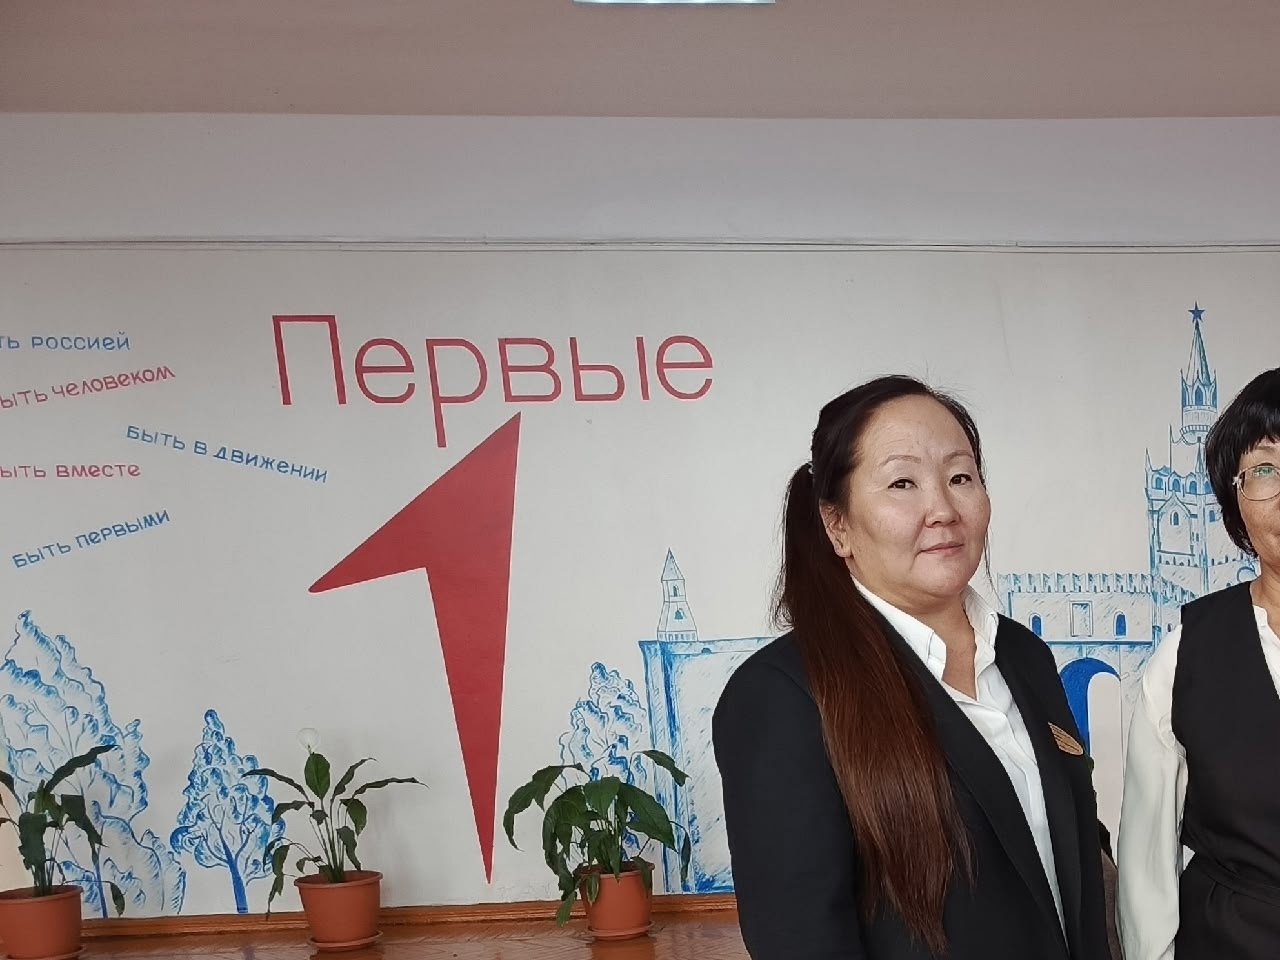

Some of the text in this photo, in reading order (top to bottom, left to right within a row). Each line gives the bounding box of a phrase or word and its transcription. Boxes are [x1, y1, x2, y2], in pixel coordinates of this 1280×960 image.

[272, 315, 713, 448] Первые
[126, 425, 186, 451] БЫТЬ
[12, 542, 72, 568] БЫТЬ
